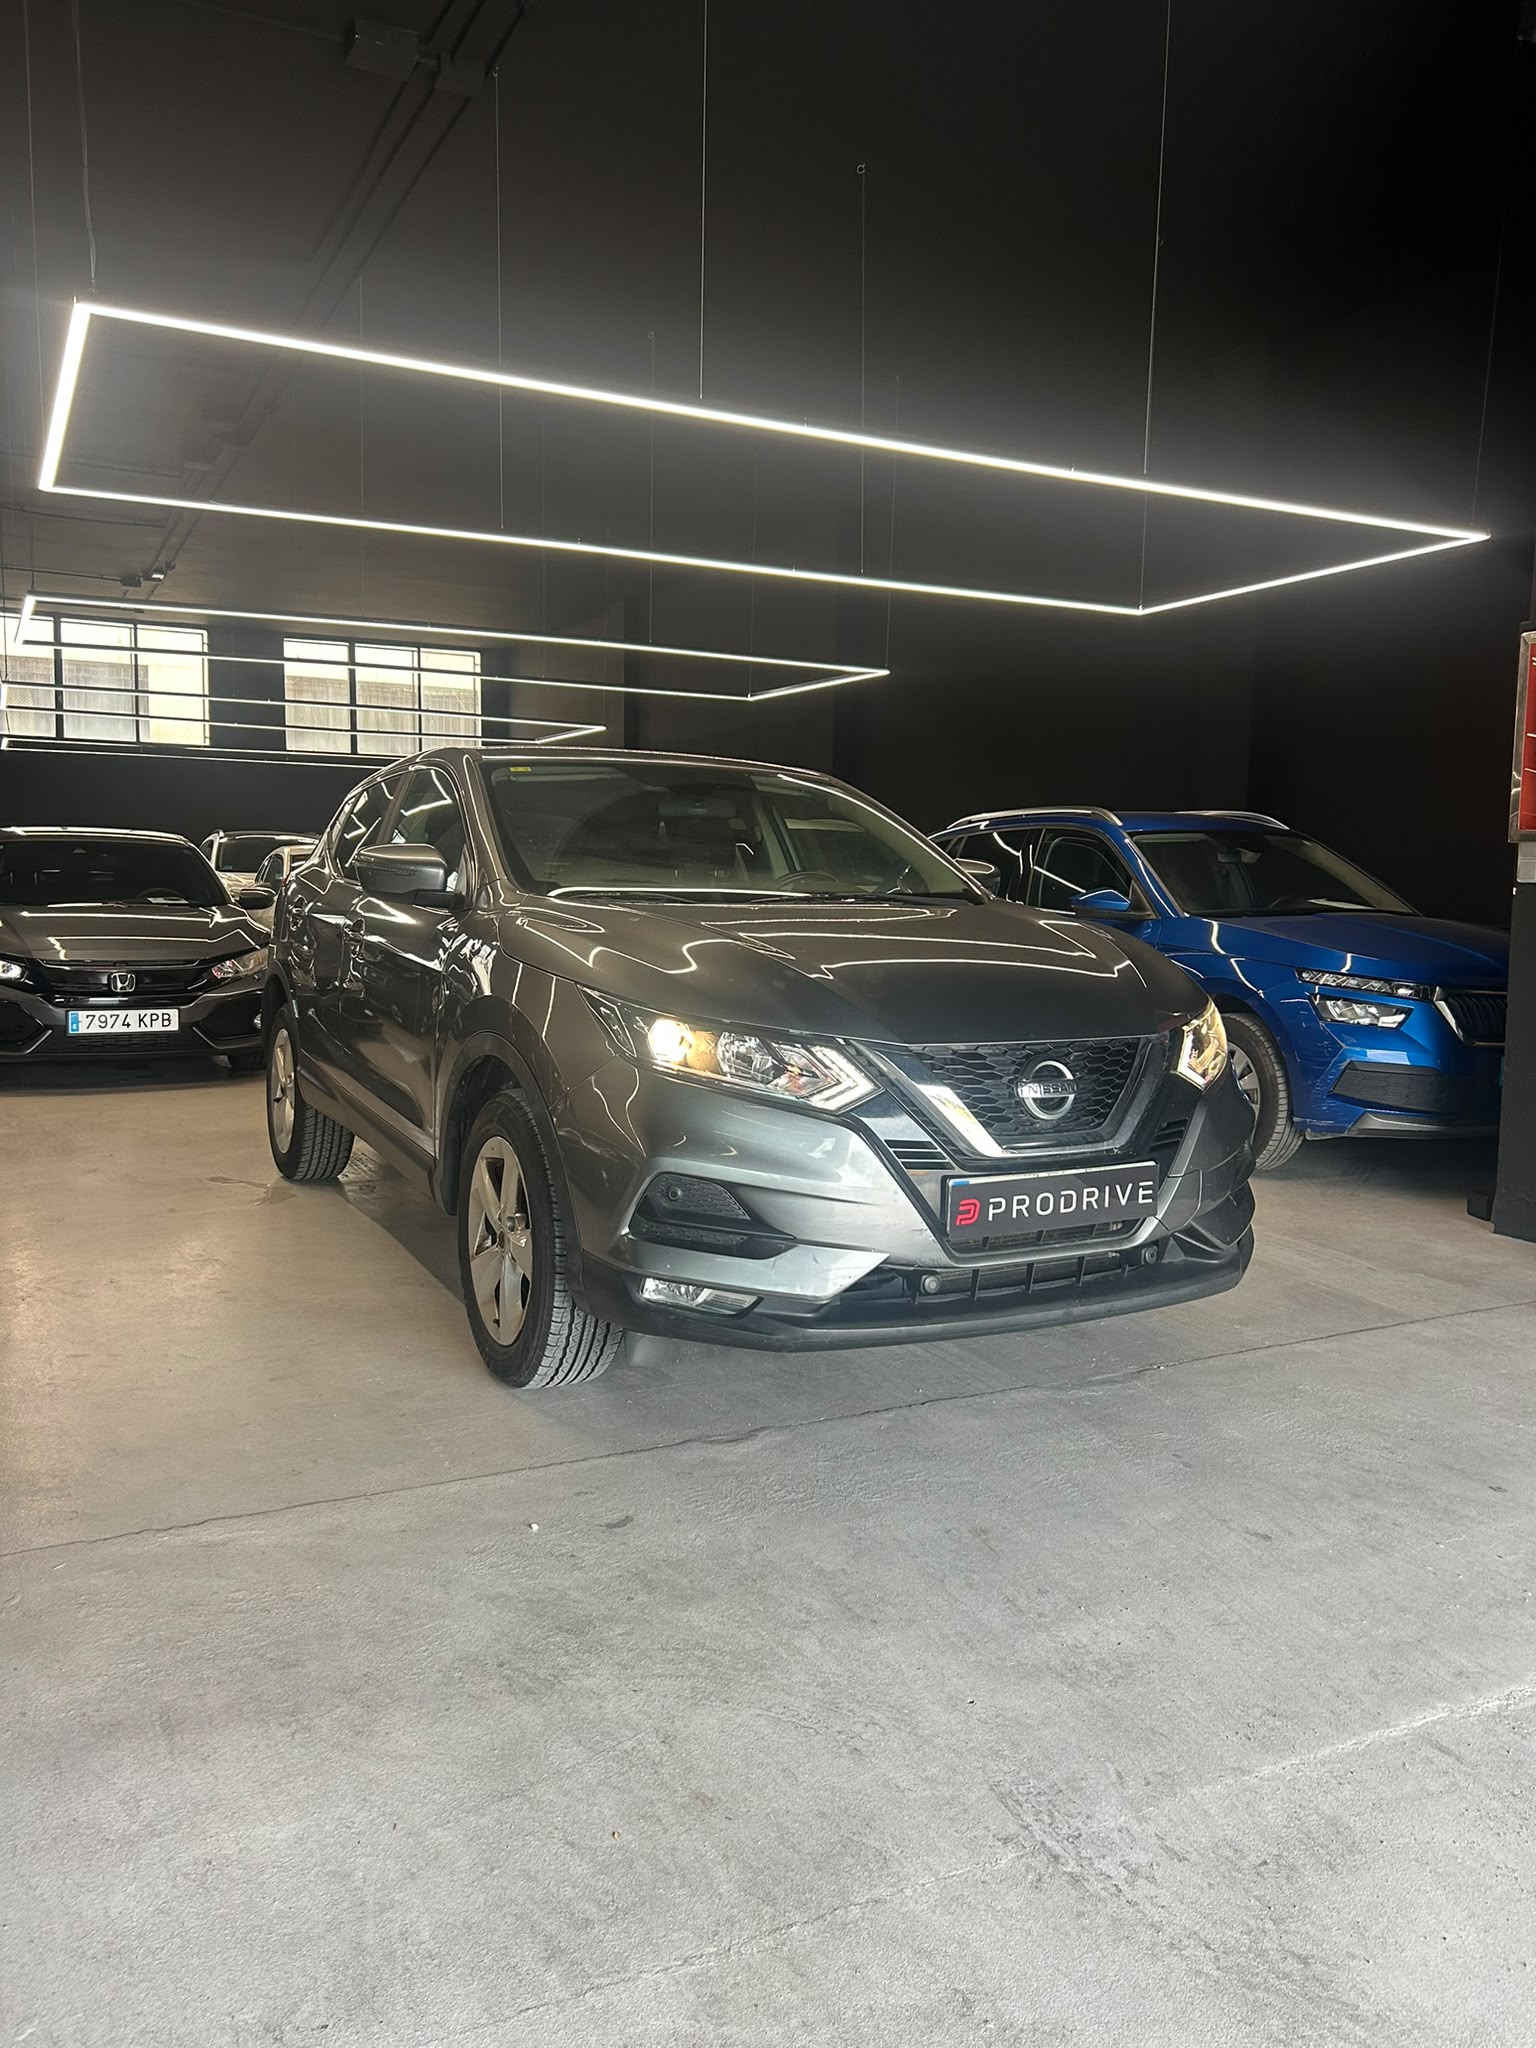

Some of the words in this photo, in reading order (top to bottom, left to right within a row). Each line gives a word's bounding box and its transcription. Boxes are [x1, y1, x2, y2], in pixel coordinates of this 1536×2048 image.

[85, 1014, 131, 1030] 7974
[138, 1012, 172, 1028] KPB
[1027, 1082, 1078, 1096] NISSAN
[987, 1181, 1154, 1222] PRODRIVE
